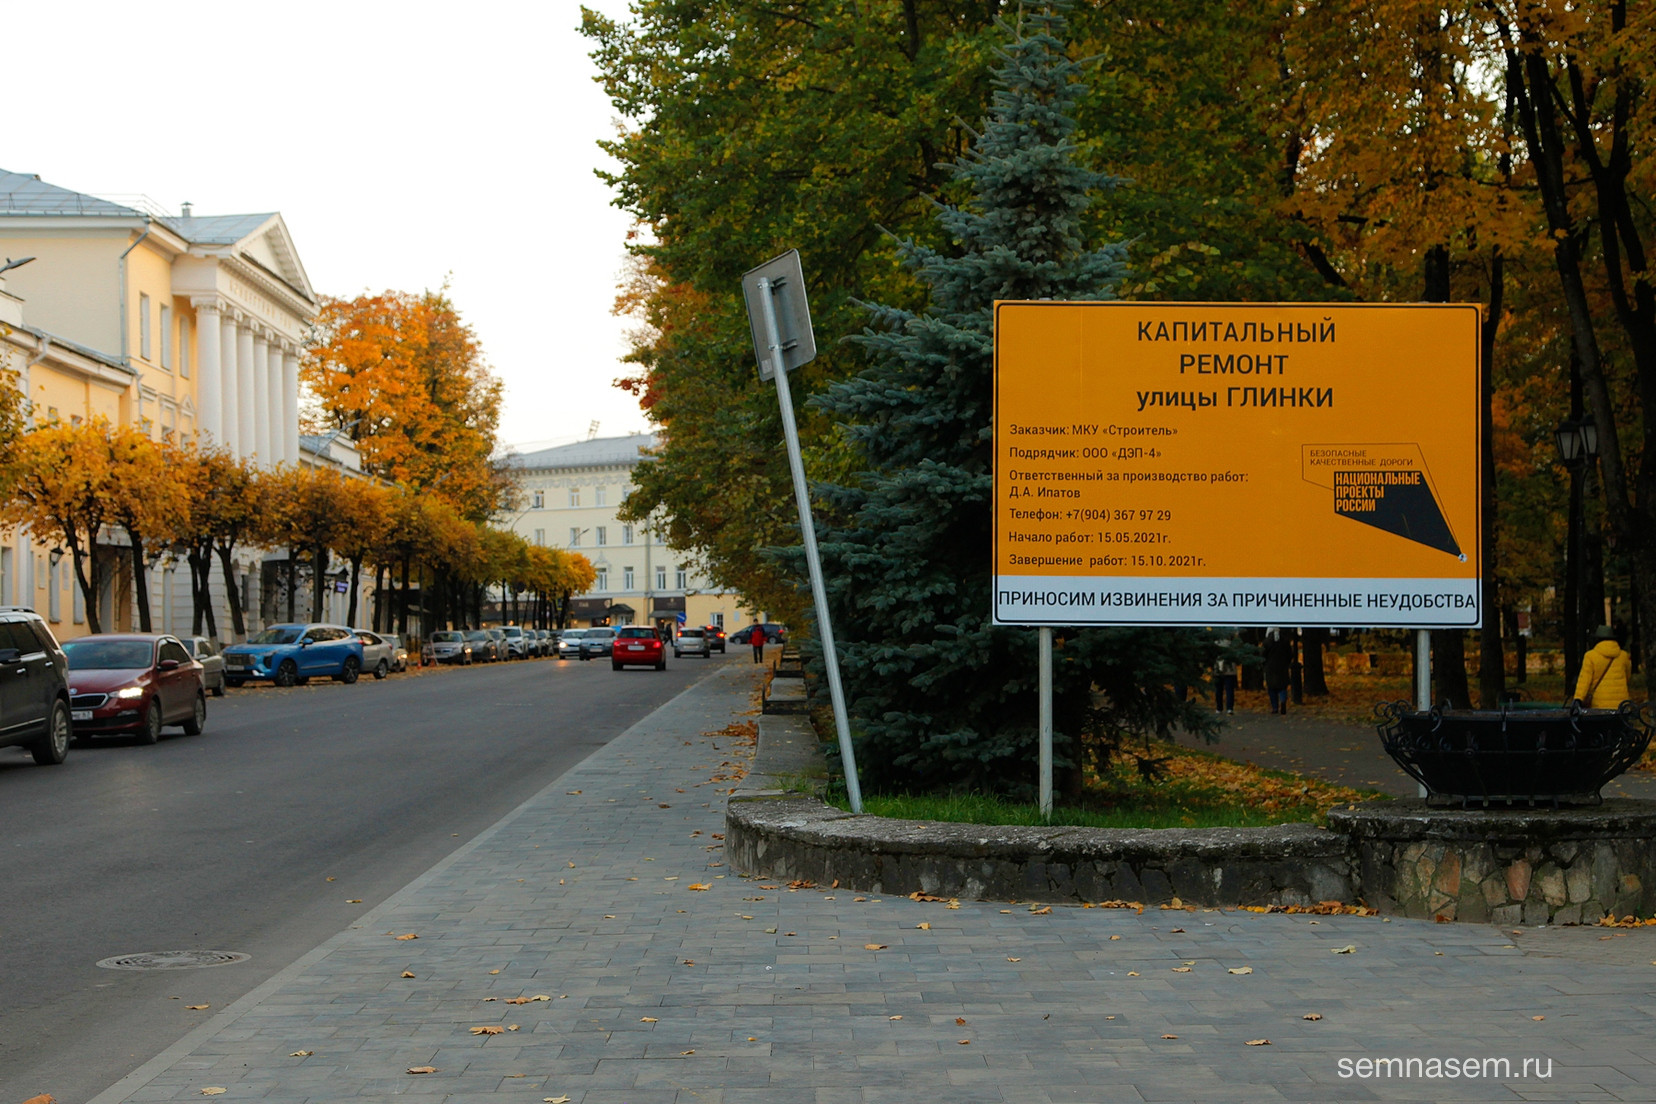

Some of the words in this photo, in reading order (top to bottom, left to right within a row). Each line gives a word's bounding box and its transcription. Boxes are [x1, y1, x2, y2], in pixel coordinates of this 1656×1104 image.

[1137, 316, 1336, 343] КАПИТАЛЬНЫЙ
[1180, 353, 1289, 375] РЕМОНТ
[1136, 391, 1217, 412] улицы
[1227, 386, 1333, 408] ГЛИНКИ
[1009, 424, 1069, 436] Заказчик:
[1072, 424, 1099, 436] МКУ
[1102, 424, 1178, 438] «Строитель»
[1009, 446, 1079, 460] Подрядчик:
[1082, 447, 1108, 459] ООО
[1111, 447, 1162, 460] «ДЭП-4»
[1379, 459, 1413, 467] ДОРОГИ
[1009, 469, 1103, 481] Ответственный
[1106, 472, 1120, 481] за
[1122, 472, 1208, 484] производство
[1210, 470, 1249, 485] работ:
[1335, 472, 1421, 486] НАЦИОНАЛЬНЫЕ
[1009, 486, 1034, 499] Д.А.
[1037, 486, 1081, 499] Ипатов
[1336, 486, 1385, 498] ПРОЕКТЫ
[1336, 499, 1376, 512] РОССИИ
[1009, 507, 1063, 522] Телефон:
[1066, 508, 1111, 522] +7(904)
[1113, 509, 1135, 521] 367
[1139, 509, 1153, 521] 97
[1156, 509, 1171, 521] 29
[1009, 531, 1052, 543] Начало
[1055, 531, 1094, 545] работ:
[1098, 531, 1171, 544] 15.05.2021г.
[1009, 554, 1083, 568] Завершение
[1089, 554, 1128, 569] работ:
[999, 591, 1095, 606] ПРИНОСИМ
[1100, 591, 1202, 607] ИЗВИНЕНИЯ
[1207, 592, 1229, 607] ЗА
[1232, 592, 1362, 608] ПРИЧИНЕННЫЕ
[1367, 593, 1476, 611] НЕУДОБСТВА
